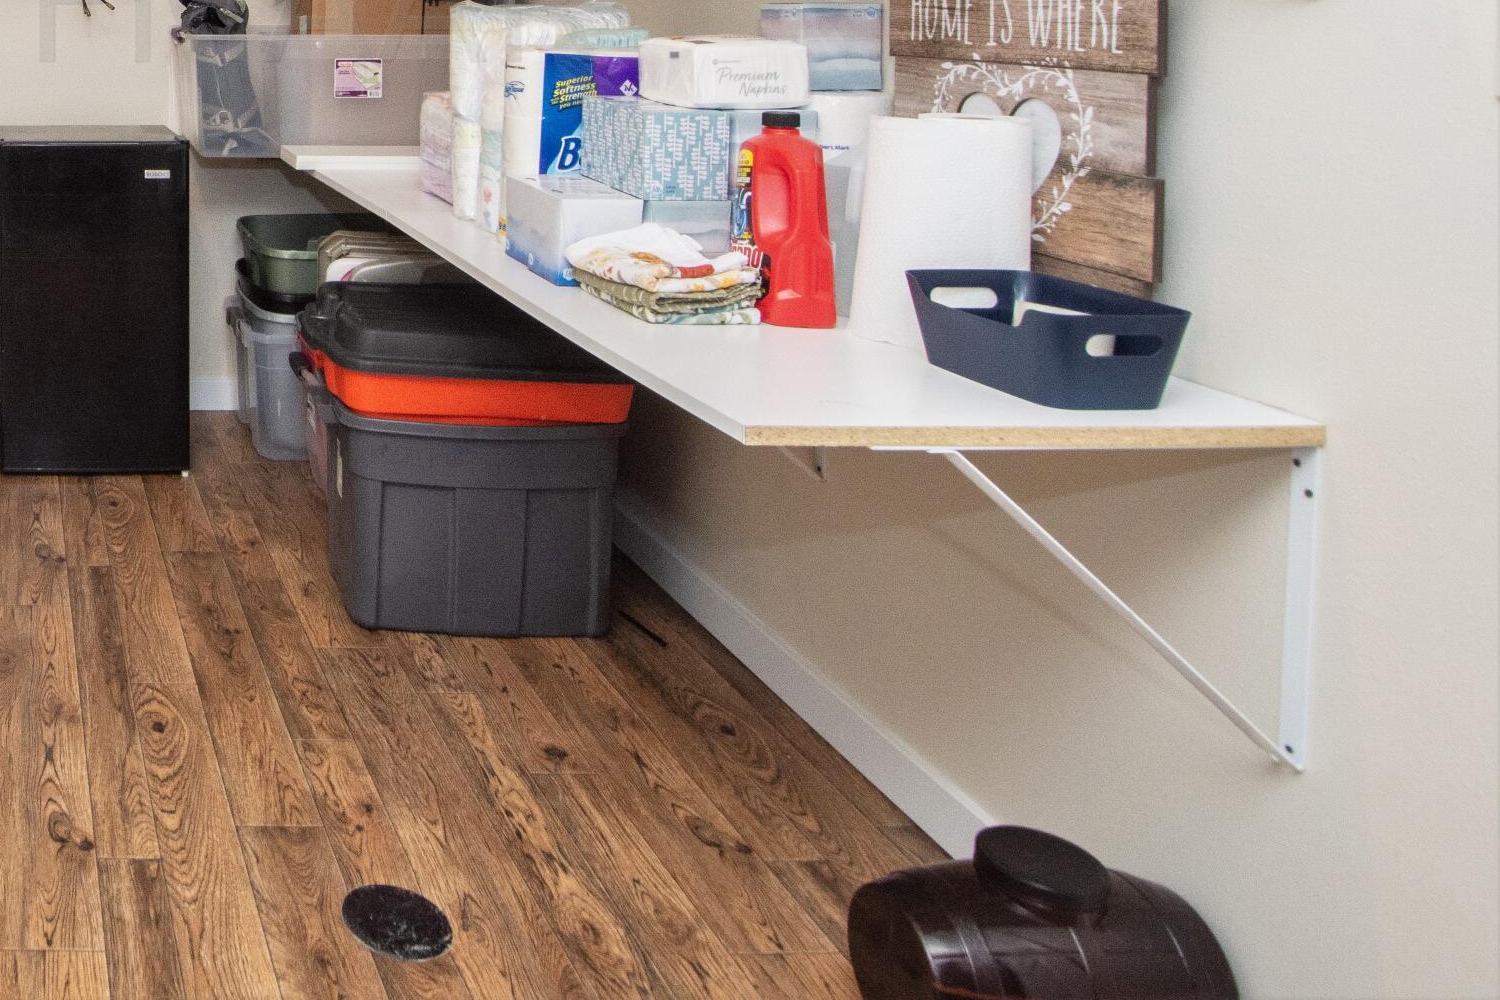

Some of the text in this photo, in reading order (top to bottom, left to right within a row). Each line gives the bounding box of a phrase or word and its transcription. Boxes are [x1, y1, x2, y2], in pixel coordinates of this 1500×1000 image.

[555, 75, 594, 89] Superior
[716, 66, 780, 84] Premium
[552, 83, 597, 98] Softness
[738, 82, 788, 97] Napkins
